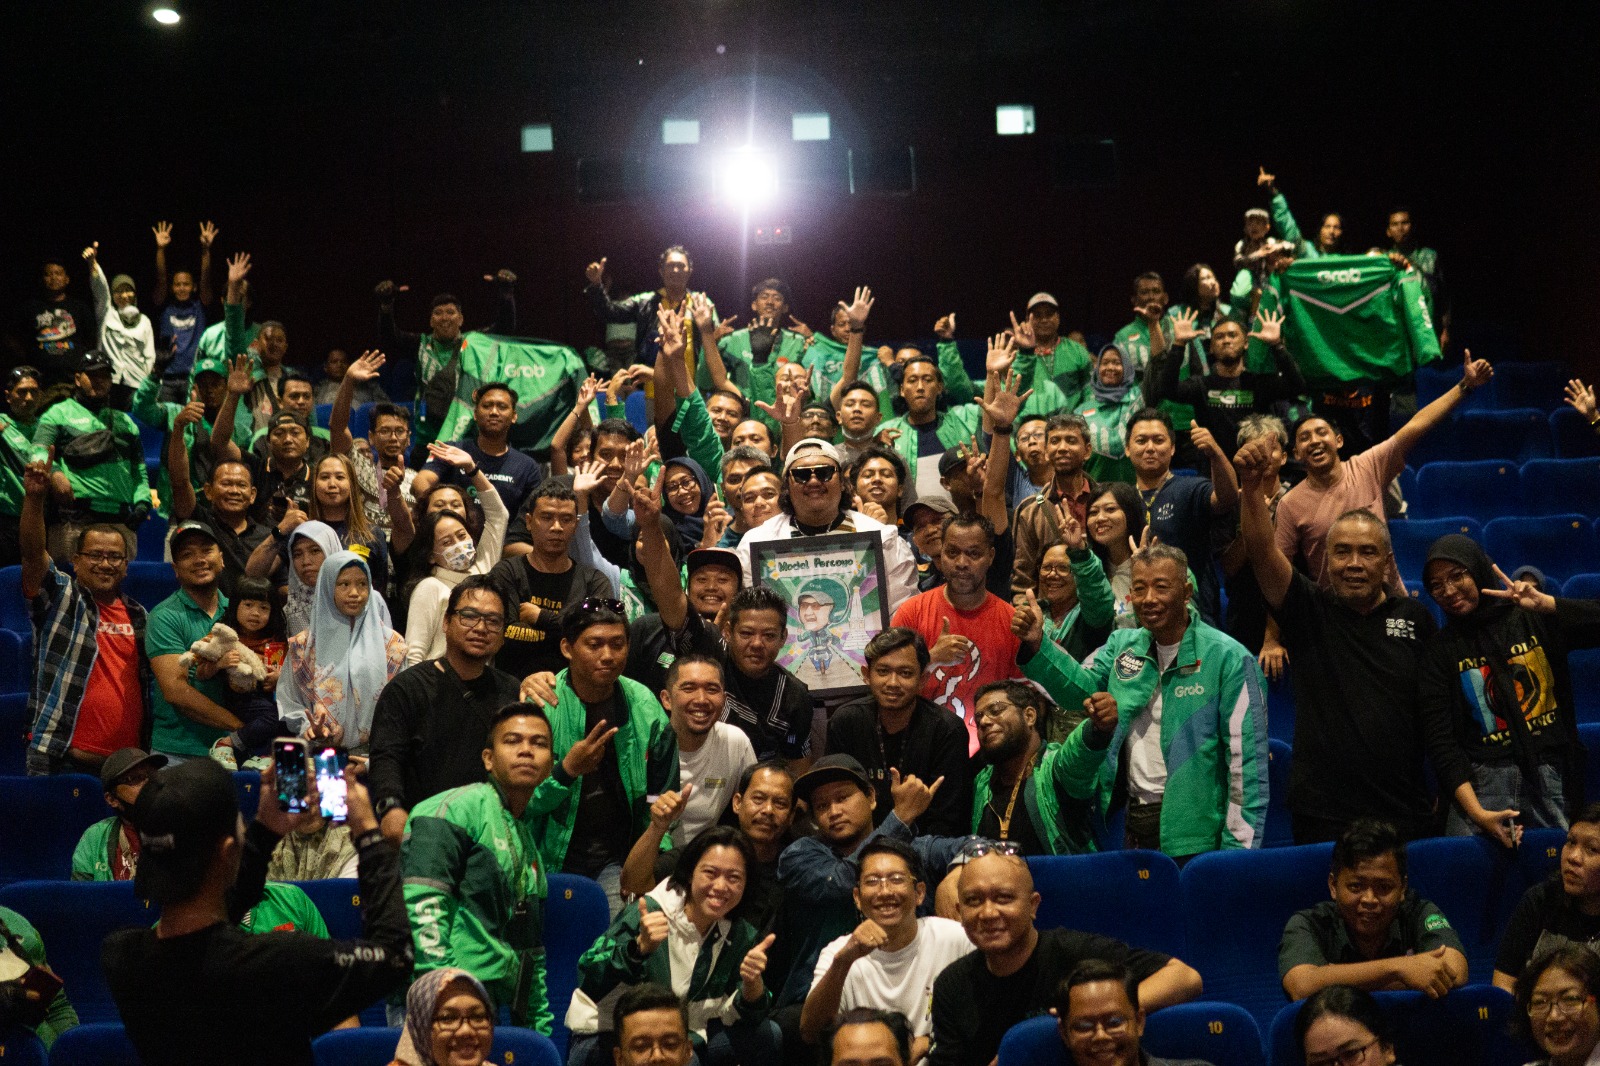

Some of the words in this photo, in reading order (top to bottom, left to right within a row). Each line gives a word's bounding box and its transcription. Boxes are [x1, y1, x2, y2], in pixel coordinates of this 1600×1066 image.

[1317, 267, 1360, 284] Grab
[504, 364, 546, 378] Grab
[484, 473, 515, 483] CADEMY.
[1174, 682, 1205, 698] Grab
[1138, 869, 1150, 880] 10
[352, 895, 361, 906] 8
[1478, 1007, 1488, 1020] 11
[1208, 1020, 1224, 1034] 10
